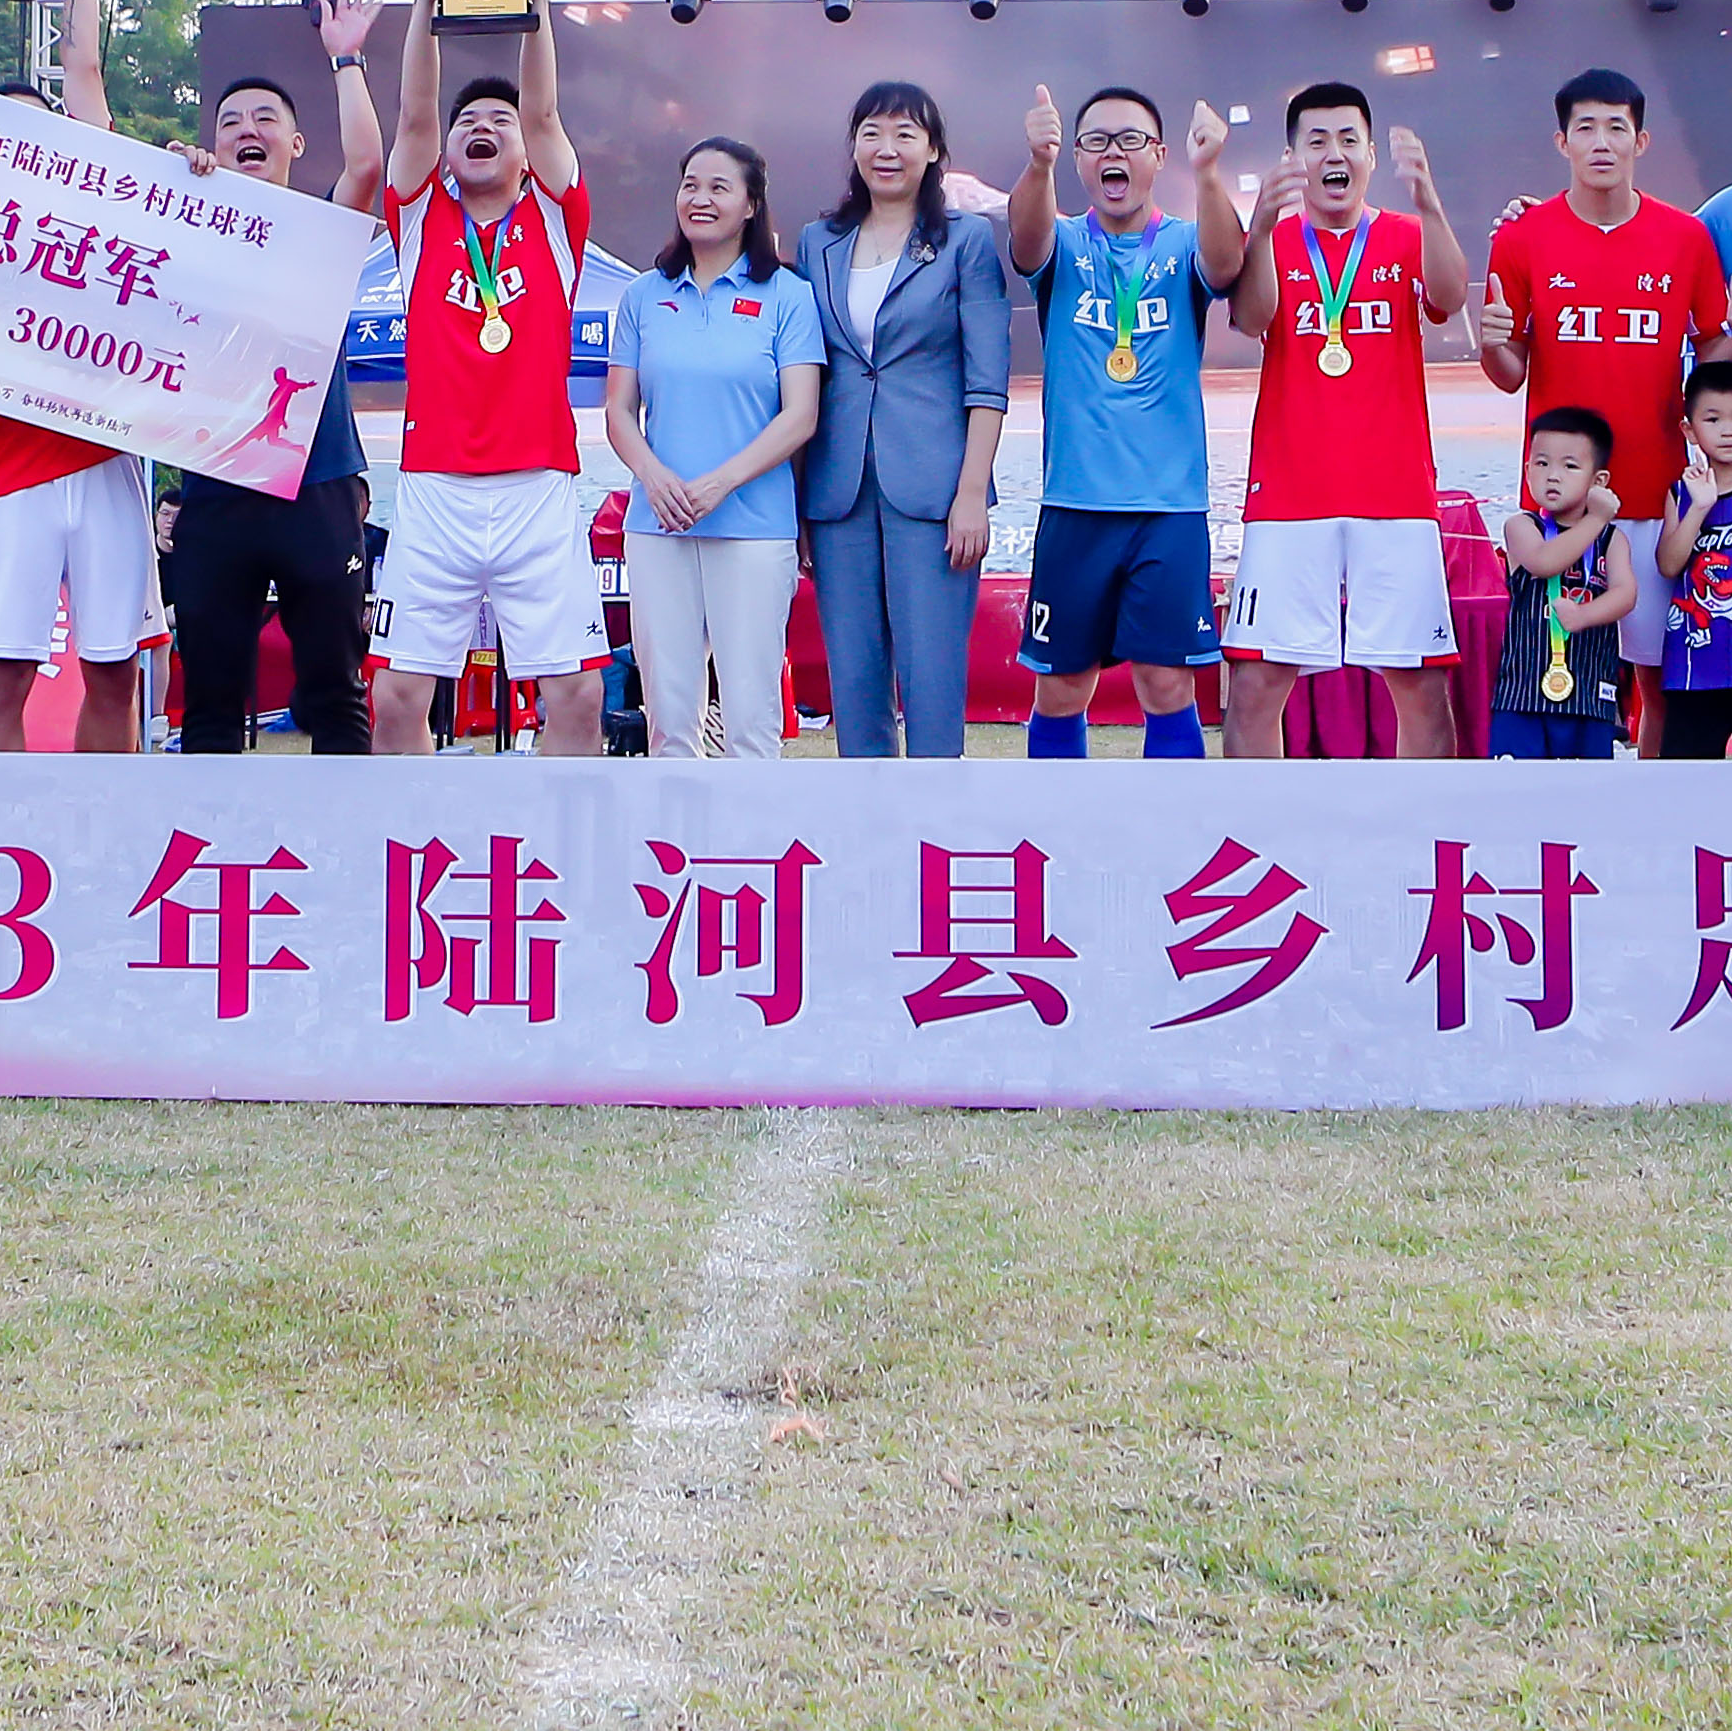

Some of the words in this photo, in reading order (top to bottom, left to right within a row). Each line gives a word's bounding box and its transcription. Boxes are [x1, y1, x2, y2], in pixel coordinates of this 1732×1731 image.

[1073, 290, 1170, 334] 红卫
[1296, 301, 1392, 336] 红卫
[1558, 306, 1659, 345] 红卫
[1236, 586, 1258, 626] 11
